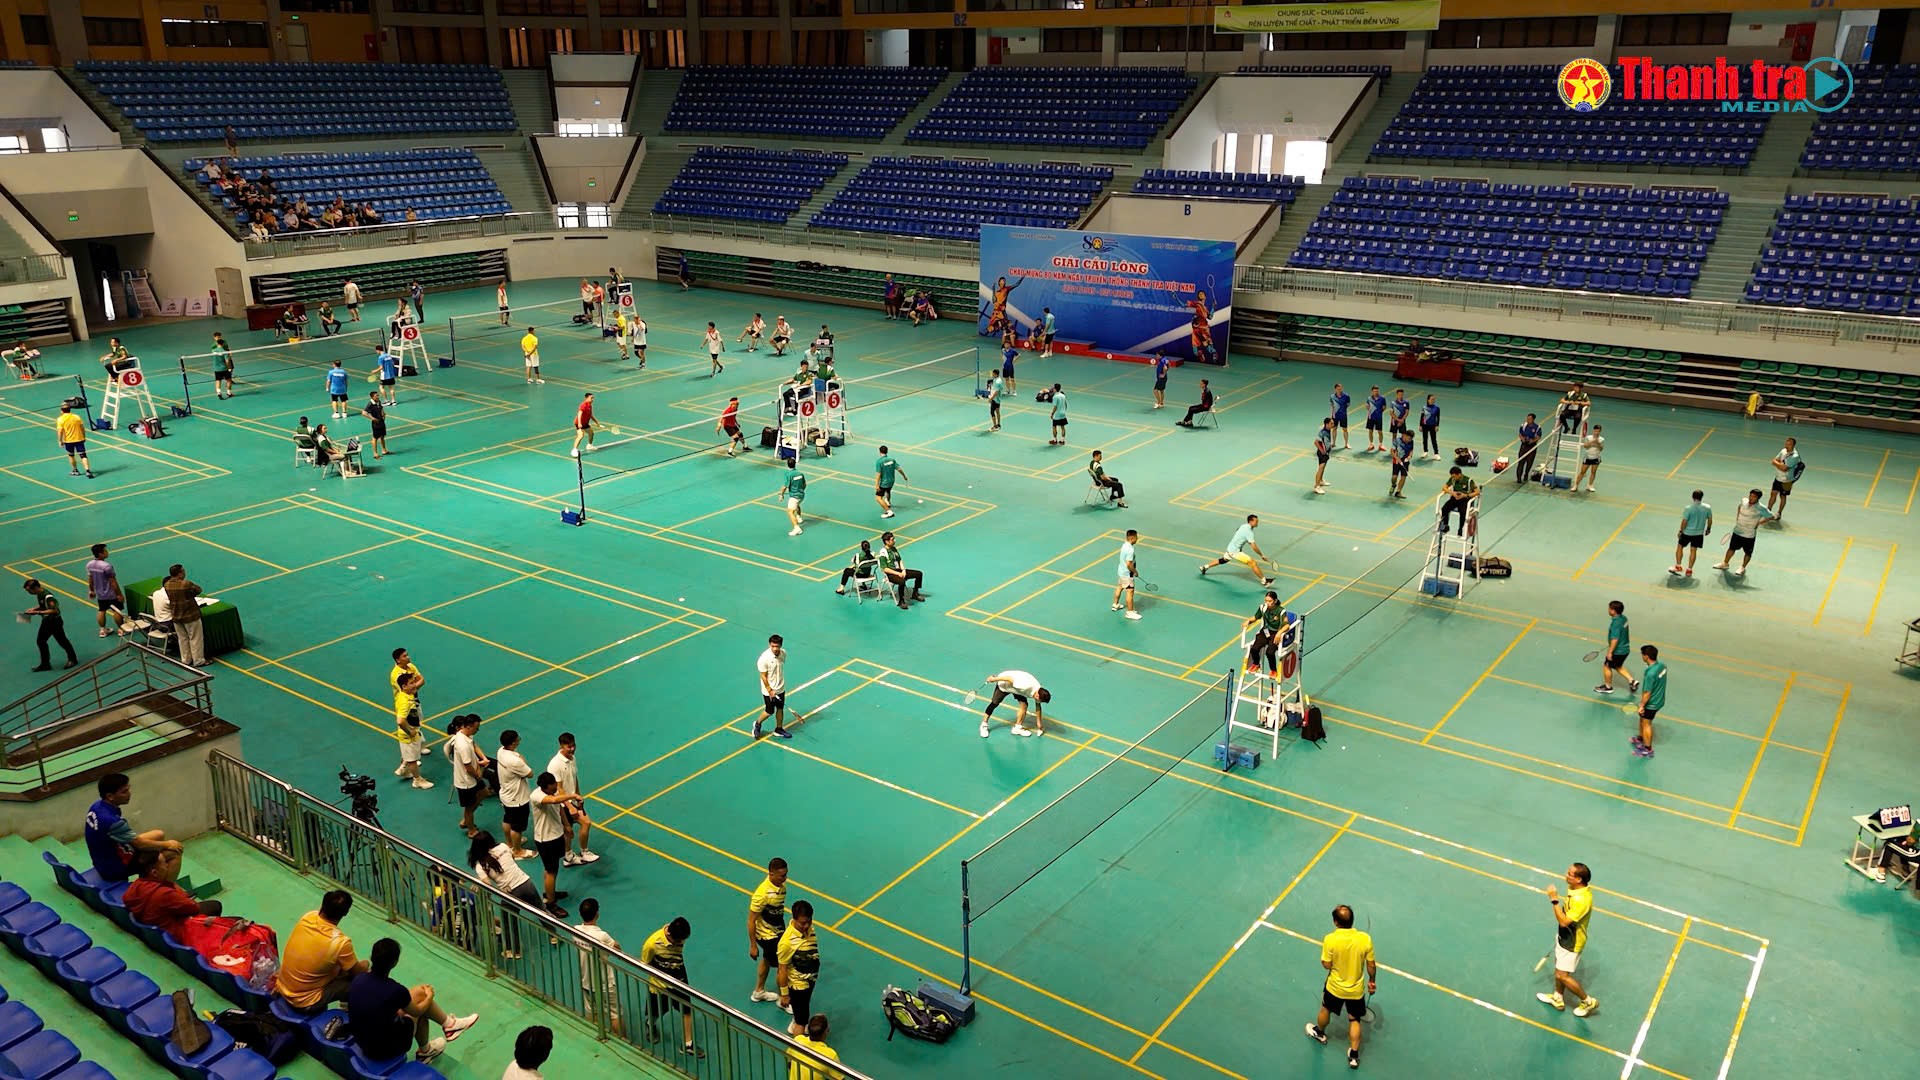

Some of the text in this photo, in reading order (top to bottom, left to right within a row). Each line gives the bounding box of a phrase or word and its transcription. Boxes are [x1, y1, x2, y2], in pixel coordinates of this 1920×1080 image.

[1185, 204, 1191, 215] B
[1152, 280, 1164, 290] TRA
[1180, 282, 1195, 293] NAM
[625, 297, 630, 306] 6
[407, 328, 414, 337] 3
[129, 372, 137, 384] 8
[832, 395, 837, 406] 5
[805, 402, 811, 414] 2
